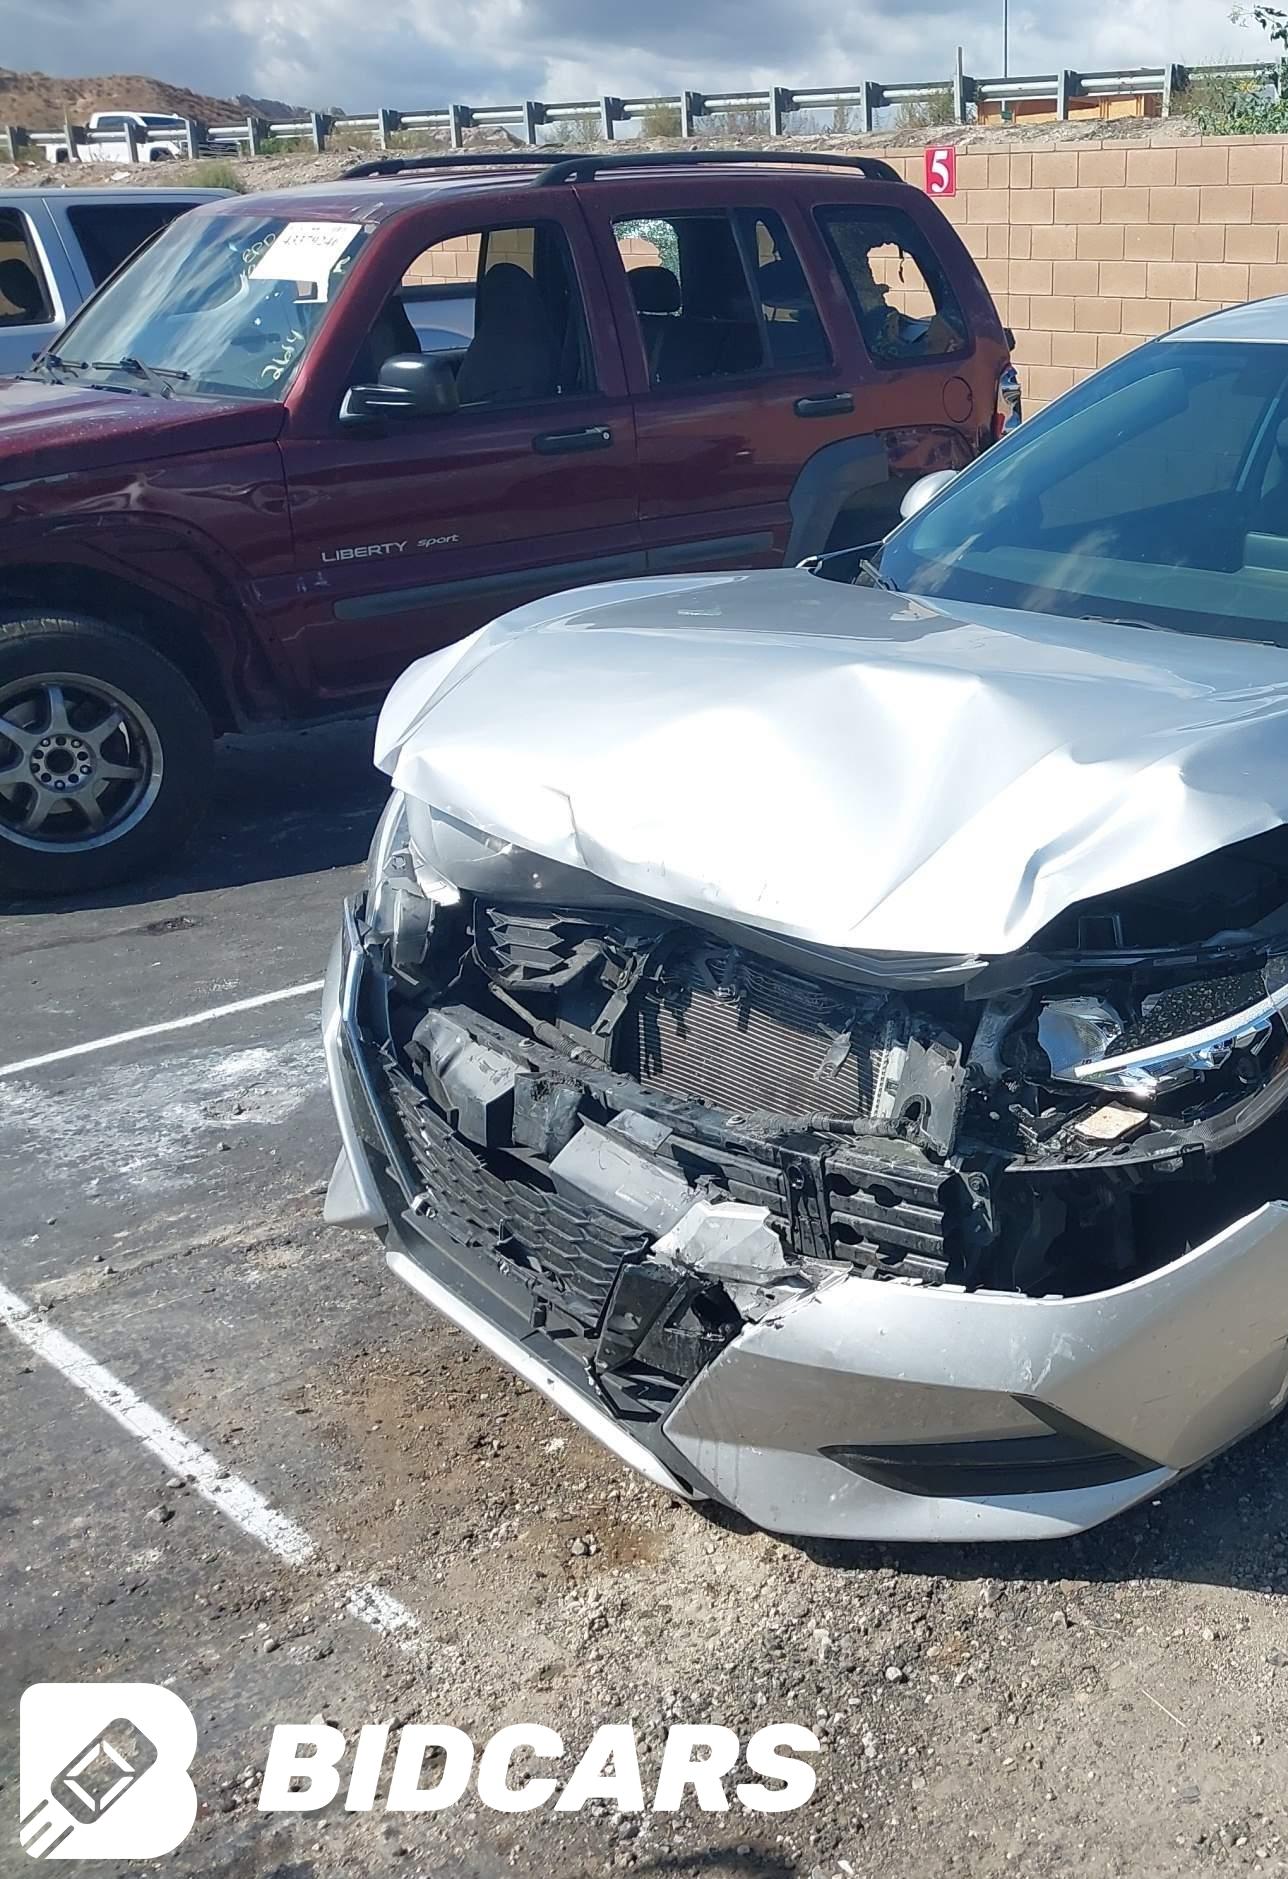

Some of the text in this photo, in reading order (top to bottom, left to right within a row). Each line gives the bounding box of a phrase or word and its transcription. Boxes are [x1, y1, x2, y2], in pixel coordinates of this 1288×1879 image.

[931, 150, 950, 193] 5
[321, 533, 460, 562] LIBERTY sport
